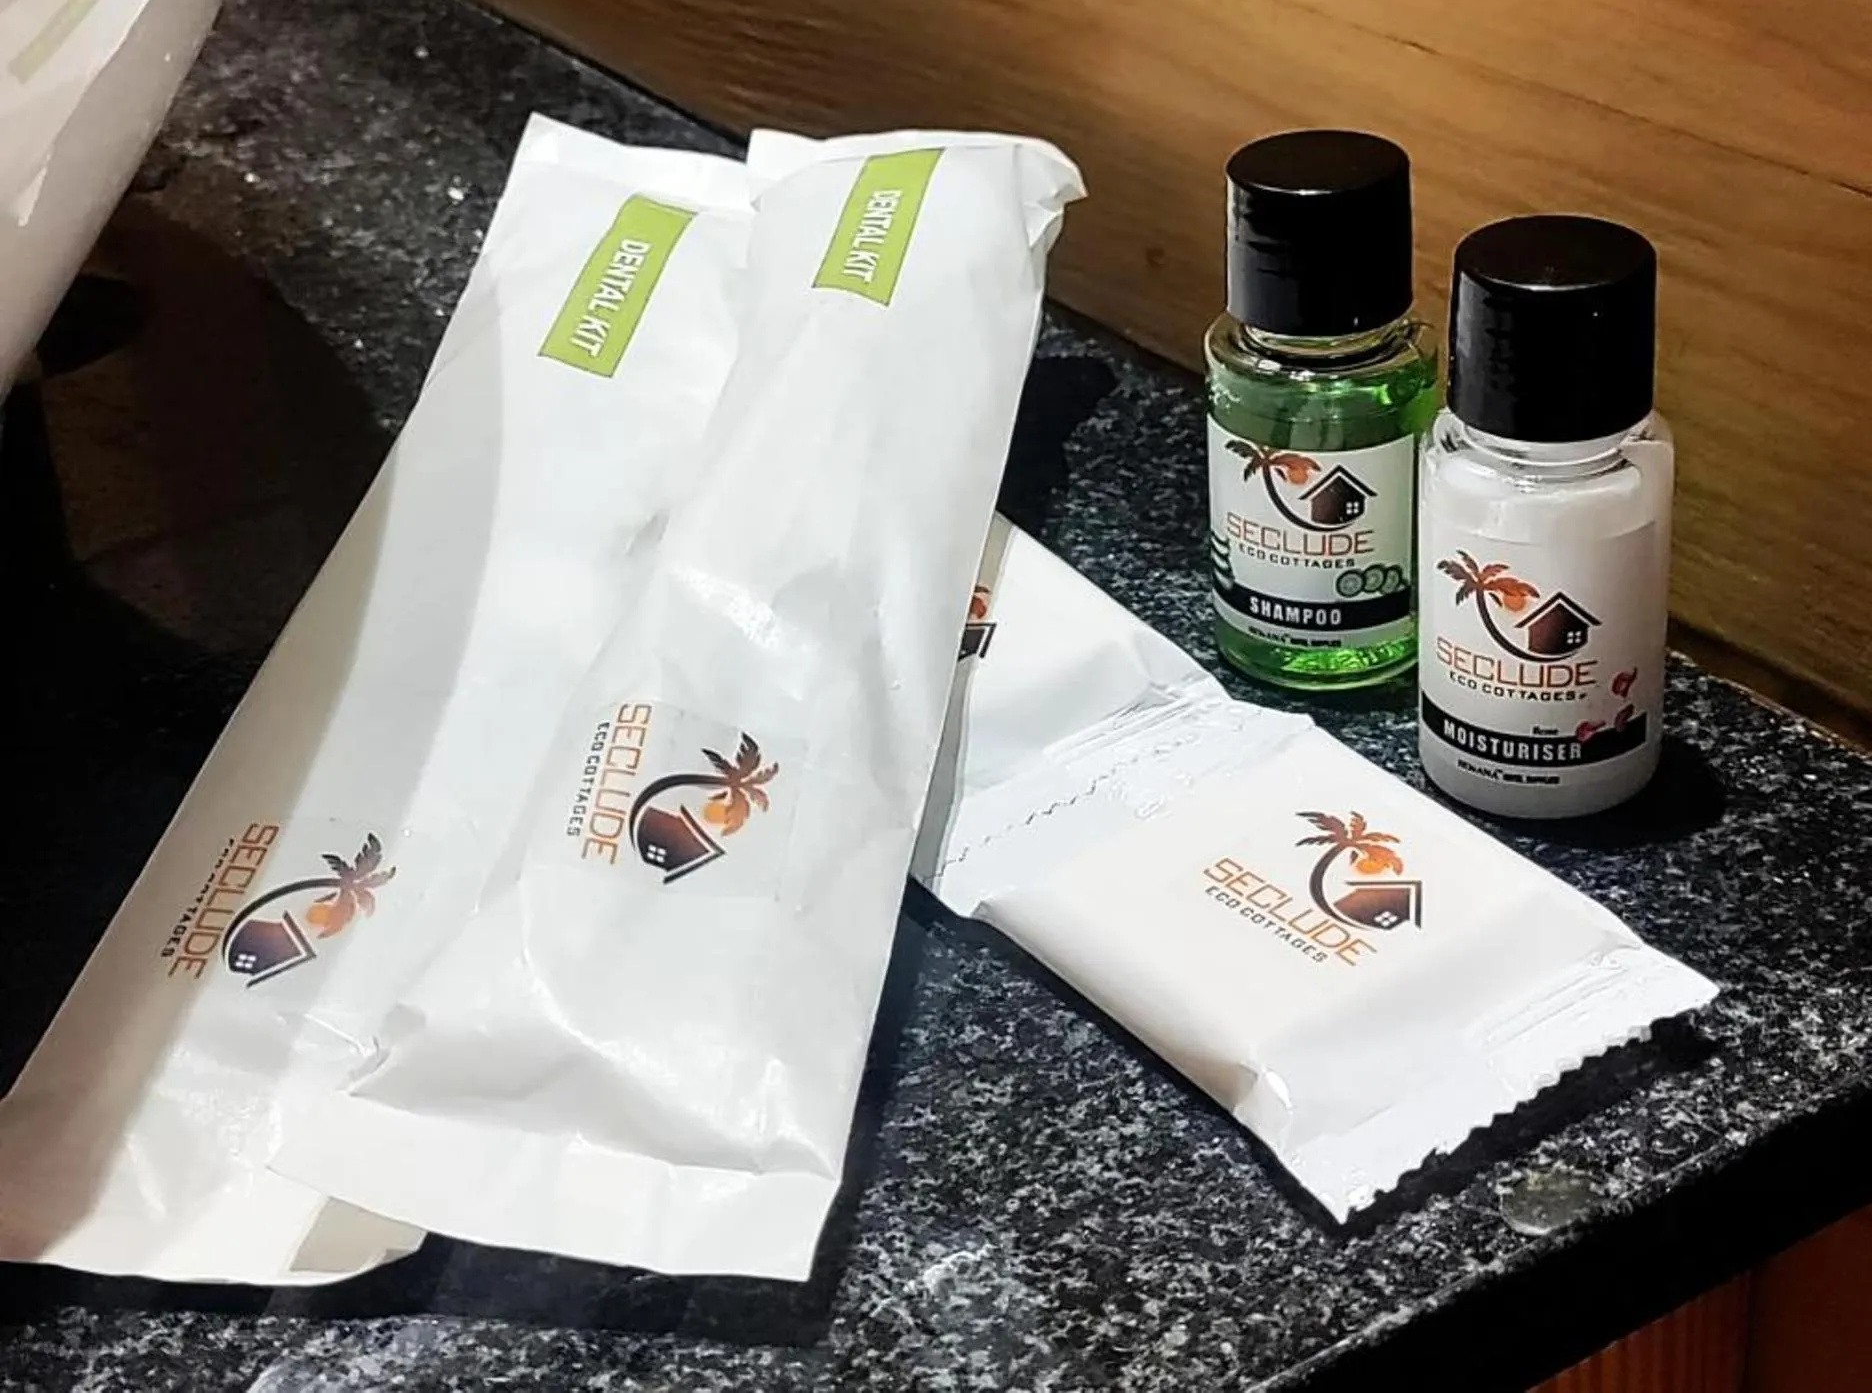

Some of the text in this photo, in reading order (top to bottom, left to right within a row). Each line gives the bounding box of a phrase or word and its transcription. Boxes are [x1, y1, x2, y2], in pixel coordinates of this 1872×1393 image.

[843, 189, 902, 284] DENTAL KIT
[569, 238, 651, 357] DENTAL KIT
[1226, 511, 1375, 556] SECLUDE
[1269, 550, 1356, 569] COTTAGES
[1249, 595, 1342, 625] SHAMPOO
[1436, 636, 1598, 688] SECLUDE
[1481, 684, 1576, 701] COTTAGES
[1443, 719, 1582, 760] MOISTURISER
[566, 754, 600, 837] COTTAGES
[581, 703, 652, 865] SECLUDE
[168, 823, 280, 979] SECLUDE
[1203, 857, 1378, 967] SECLUDE
[1205, 885, 1328, 963] ECO COTTAGES
